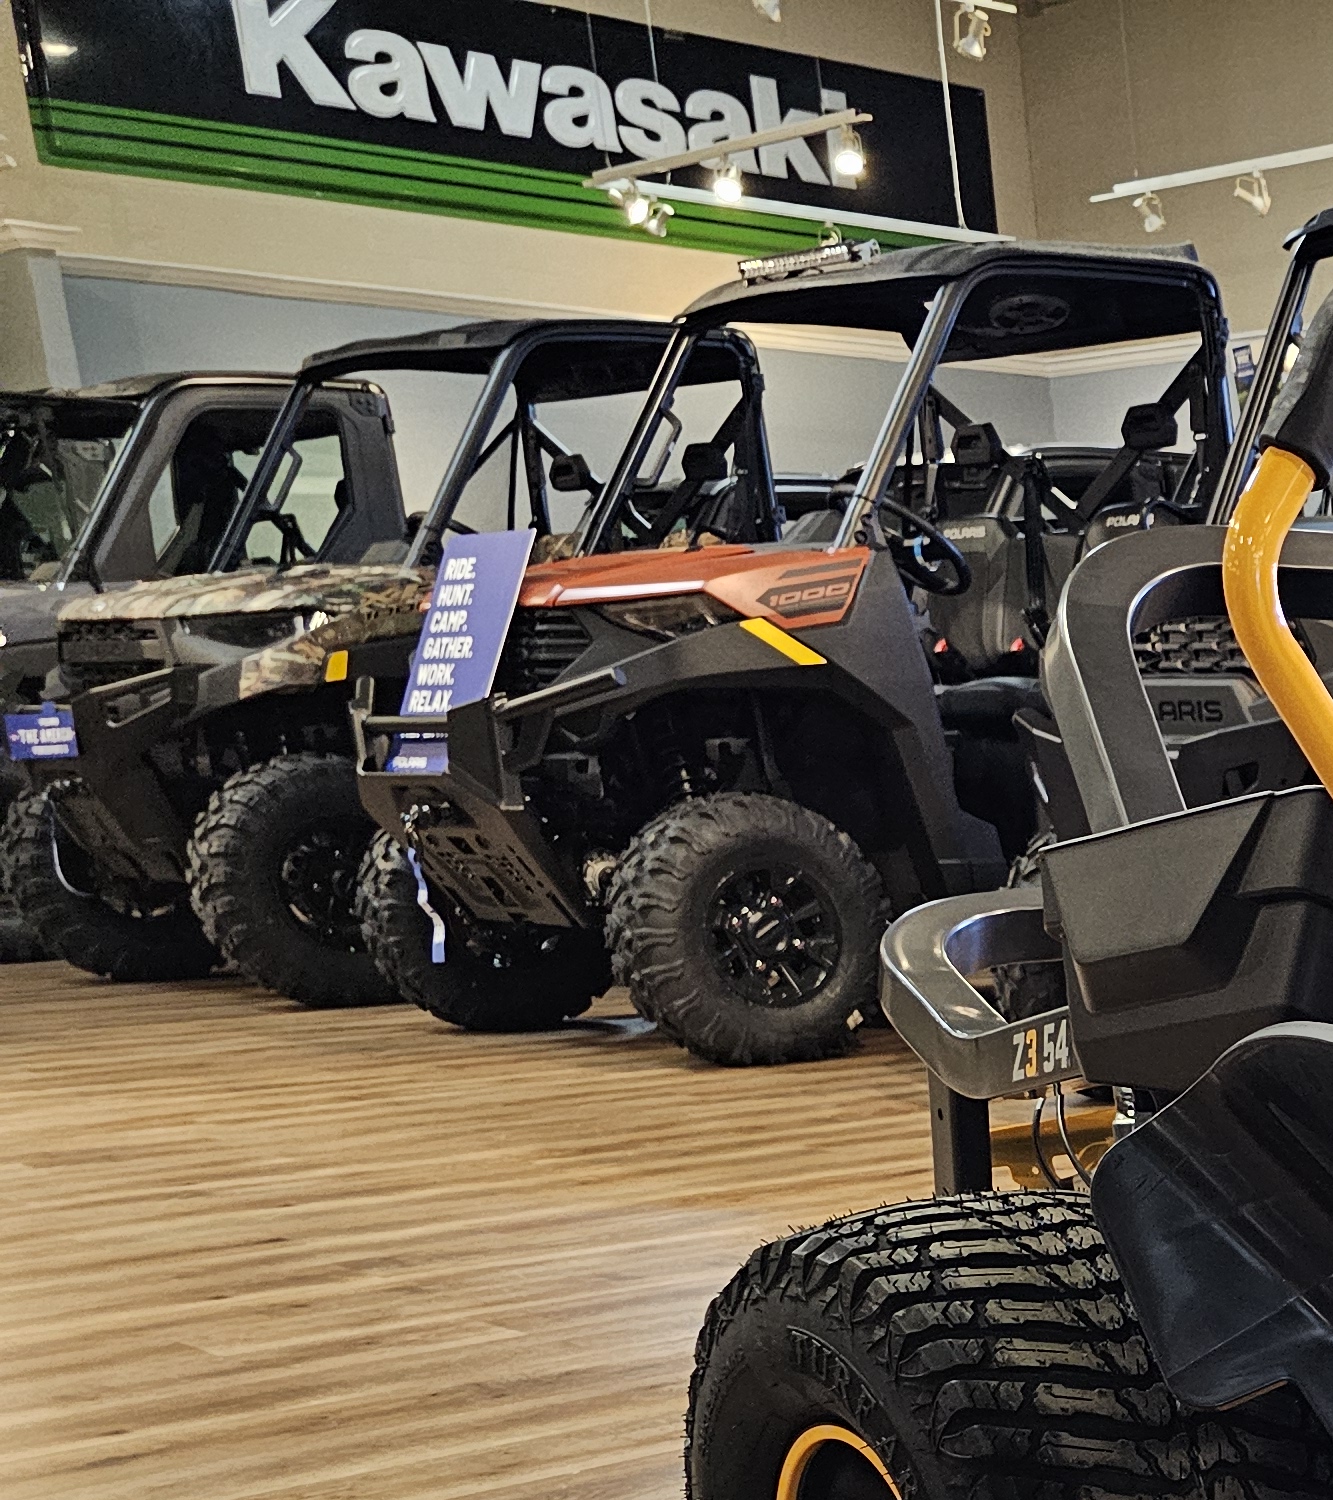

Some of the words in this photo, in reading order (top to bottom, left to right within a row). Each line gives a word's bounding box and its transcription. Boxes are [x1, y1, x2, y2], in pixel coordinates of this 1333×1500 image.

[229, 0, 860, 191] Kawasaki
[443, 557, 477, 581] RIDE.
[436, 583, 475, 607] HUNT.
[769, 581, 851, 607] 1000
[429, 610, 468, 634] CAMP.
[422, 636, 473, 660] GATHER.
[416, 663, 455, 686] WORK.
[408, 690, 452, 713] RELAX.
[1159, 700, 1223, 722] ARIS
[1012, 1028, 1038, 1082] Z3
